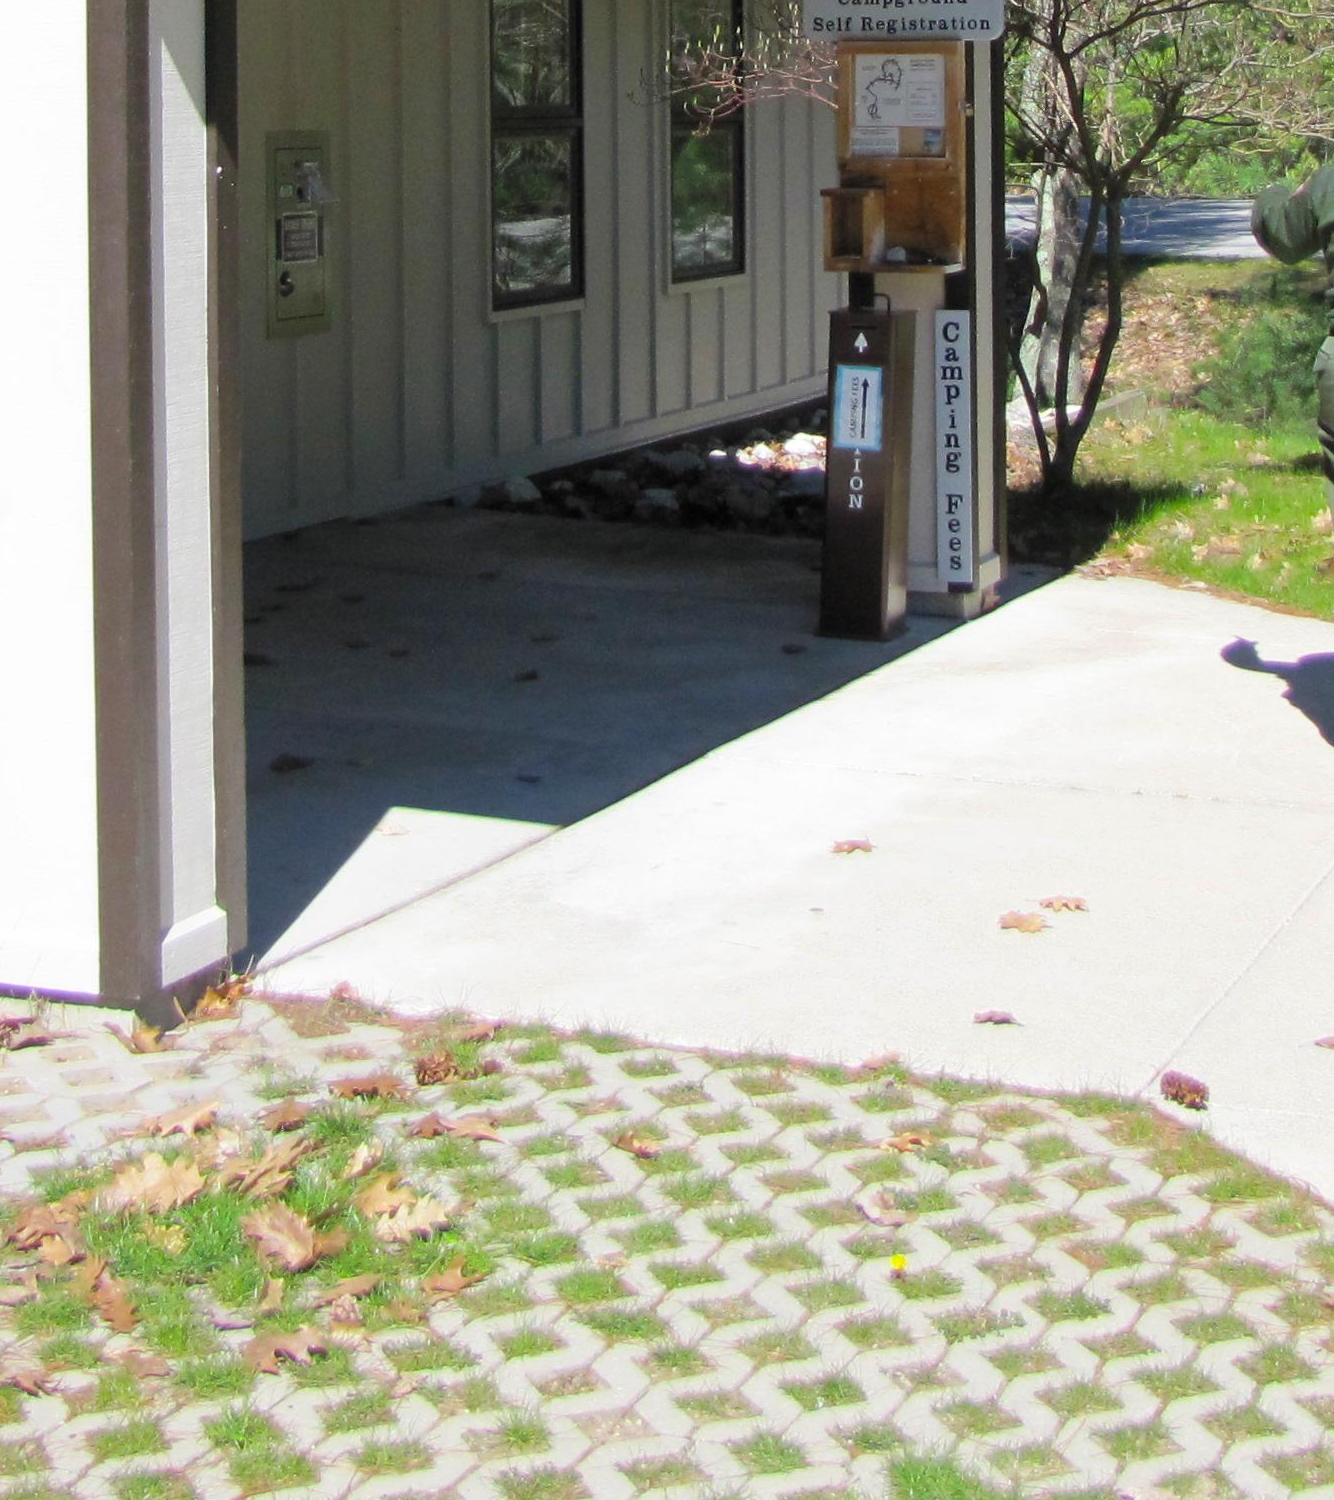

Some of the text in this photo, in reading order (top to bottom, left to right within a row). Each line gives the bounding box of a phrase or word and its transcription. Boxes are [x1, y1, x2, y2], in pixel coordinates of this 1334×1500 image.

[813, 16, 991, 35] Self Registration
[849, 376, 860, 438] CAMPING FEES
[940, 321, 964, 474] Camping
[944, 494, 964, 571] Fees
